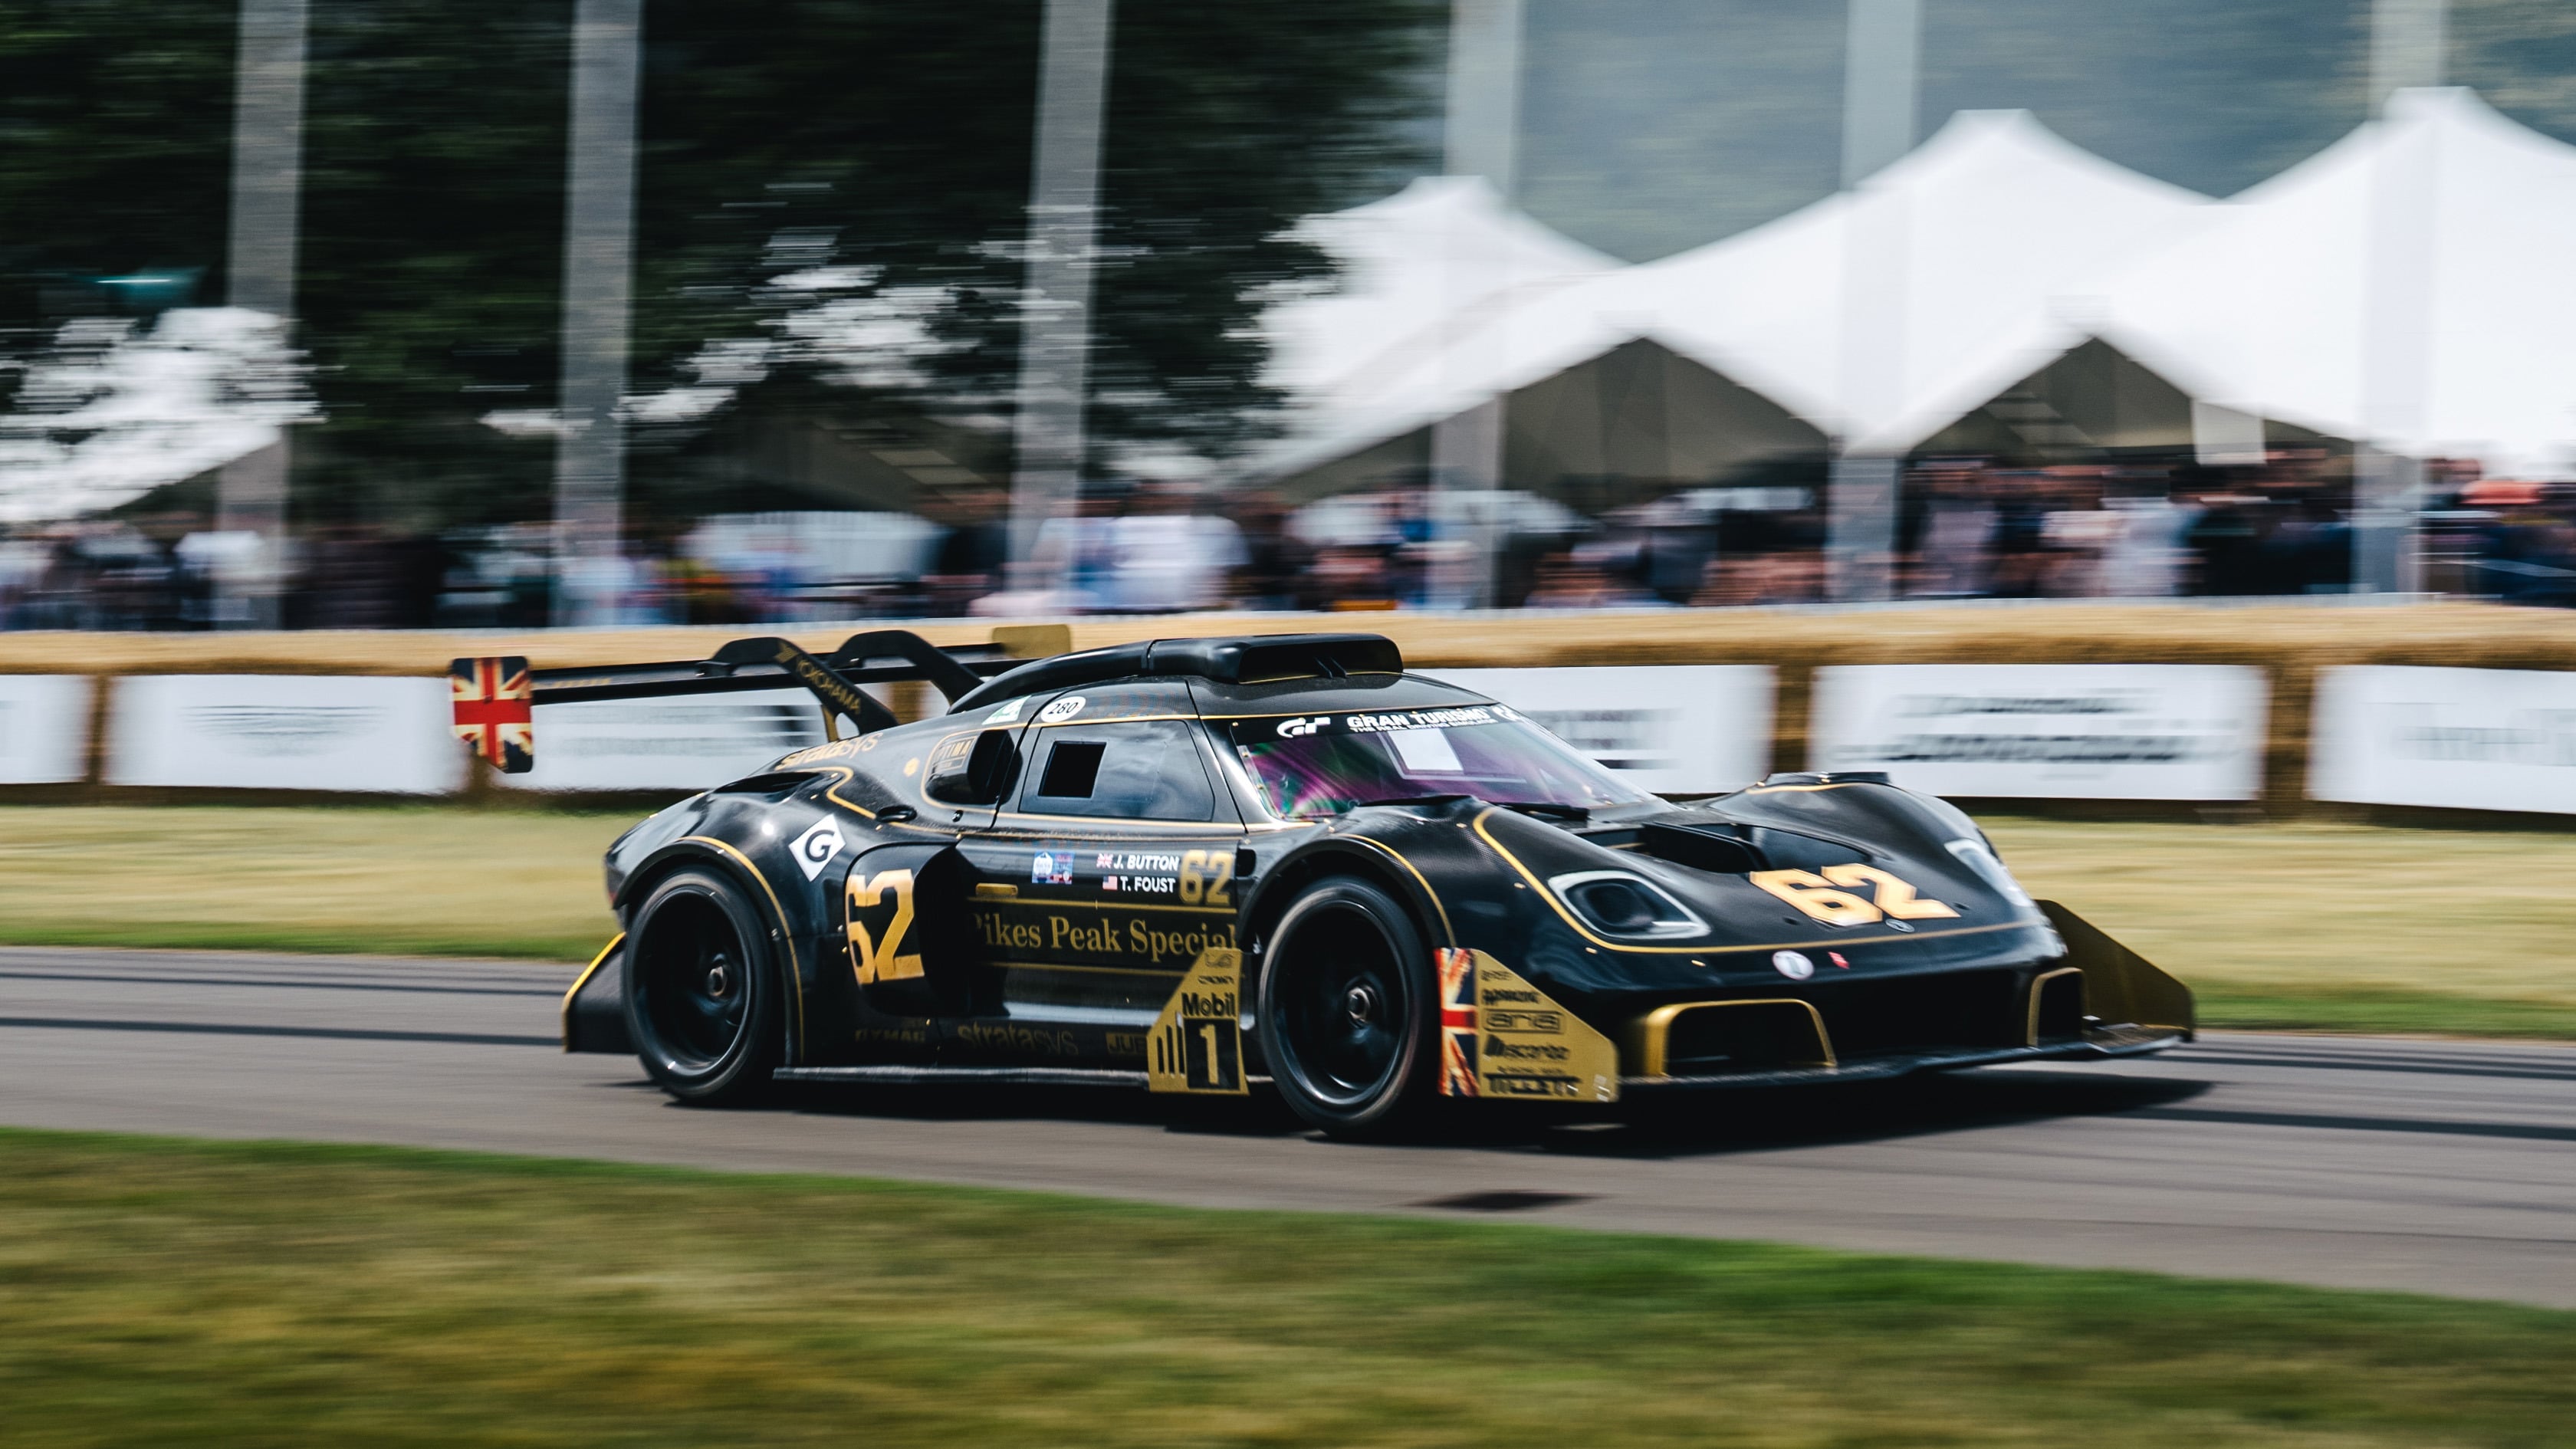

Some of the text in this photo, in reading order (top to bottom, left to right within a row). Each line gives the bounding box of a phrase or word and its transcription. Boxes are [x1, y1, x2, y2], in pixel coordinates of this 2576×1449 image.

[797, 656, 861, 715] YOKOHAMA
[1047, 702, 1078, 715] 280
[1347, 708, 1491, 728] GRAN TURISMO
[805, 830, 835, 863] G
[1113, 854, 1180, 871] J. BUTTON
[1120, 876, 1175, 893] T. FOUST
[1179, 849, 1234, 905] 62
[1750, 863, 1962, 927] 62
[845, 869, 925, 984] 62
[1049, 916, 1122, 952] Peak
[1129, 919, 1237, 962] Special
[1181, 993, 1236, 1016] Mobil
[1200, 1024, 1219, 1085] 1
